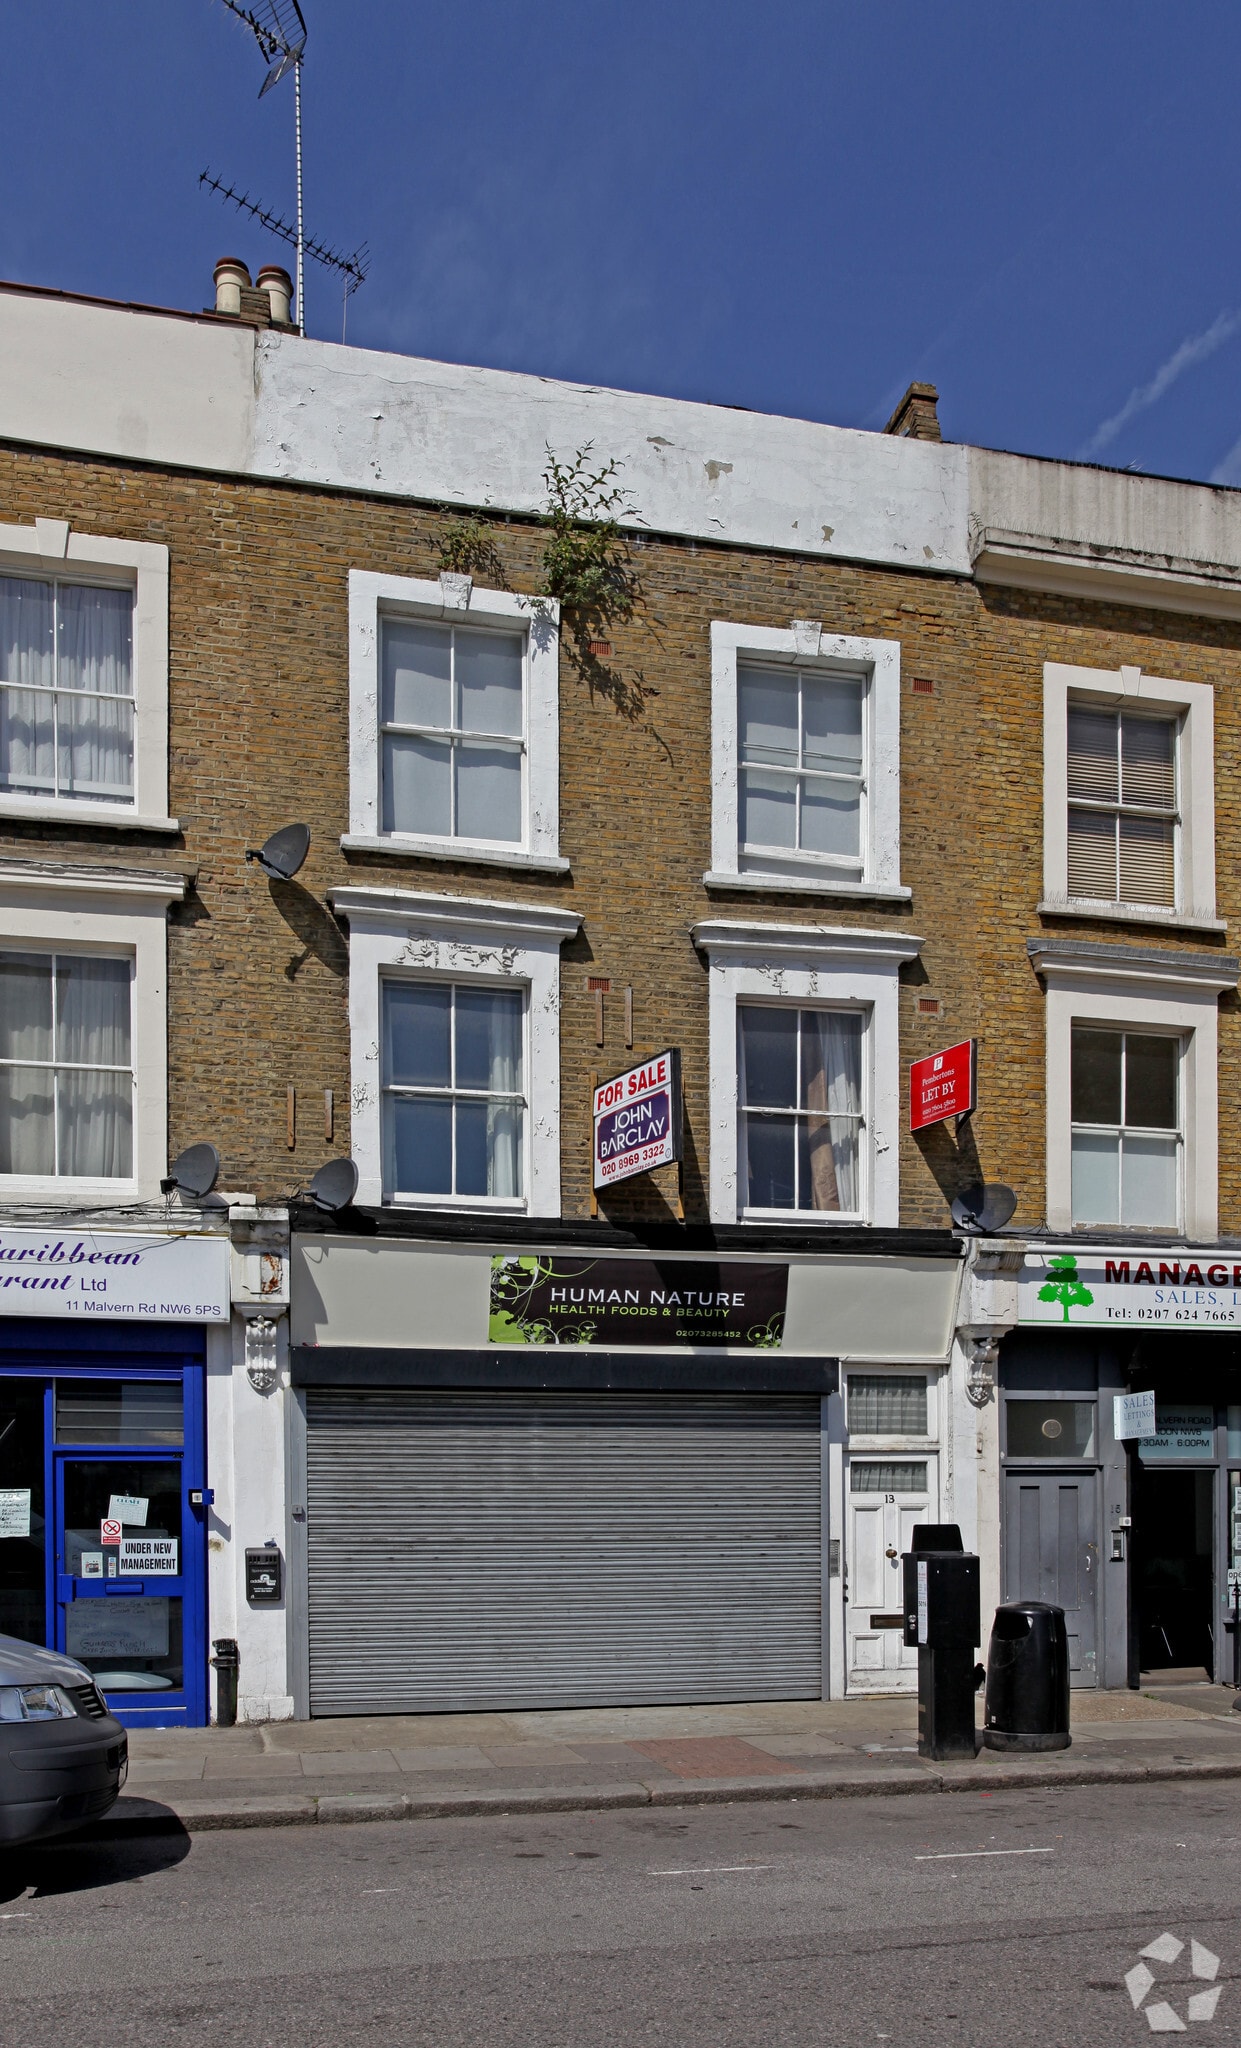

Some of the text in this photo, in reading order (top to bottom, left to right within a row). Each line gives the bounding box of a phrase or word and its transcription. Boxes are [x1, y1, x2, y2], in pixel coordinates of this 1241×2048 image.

[922, 1069, 955, 1086] Pembertons
[597, 1060, 667, 1111] FOR SALE
[922, 1080, 956, 1104] LET BY
[611, 1101, 652, 1133] JOHN
[601, 1117, 665, 1158] BARCLAY
[602, 1144, 665, 1176] 020 8969 3322
[0, 1240, 144, 1266] aribbean
[0, 1275, 107, 1292] rant Ltd
[551, 1287, 745, 1307] HUMAN NATURE
[1155, 1290, 1224, 1306] SALES,
[66, 1301, 221, 1316] 11 Malvern Rd NW6 5PS
[550, 1304, 730, 1318] HEALTH FOODS & BEAUTY
[1106, 1307, 1235, 1321] Tel: 0207 624 7665
[675, 1330, 741, 1338] 02073285452
[1123, 1394, 1154, 1409] SALES
[1123, 1409, 1155, 1421] LETTINGS
[1188, 1416, 1212, 1424] ROAD
[1136, 1420, 1142, 1428] &
[1177, 1439, 1210, 1447] 6:00PM
[884, 1494, 895, 1504] 13
[125, 1542, 172, 1554] UNDER NEW
[121, 1558, 176, 1570] MANAGEMENT
